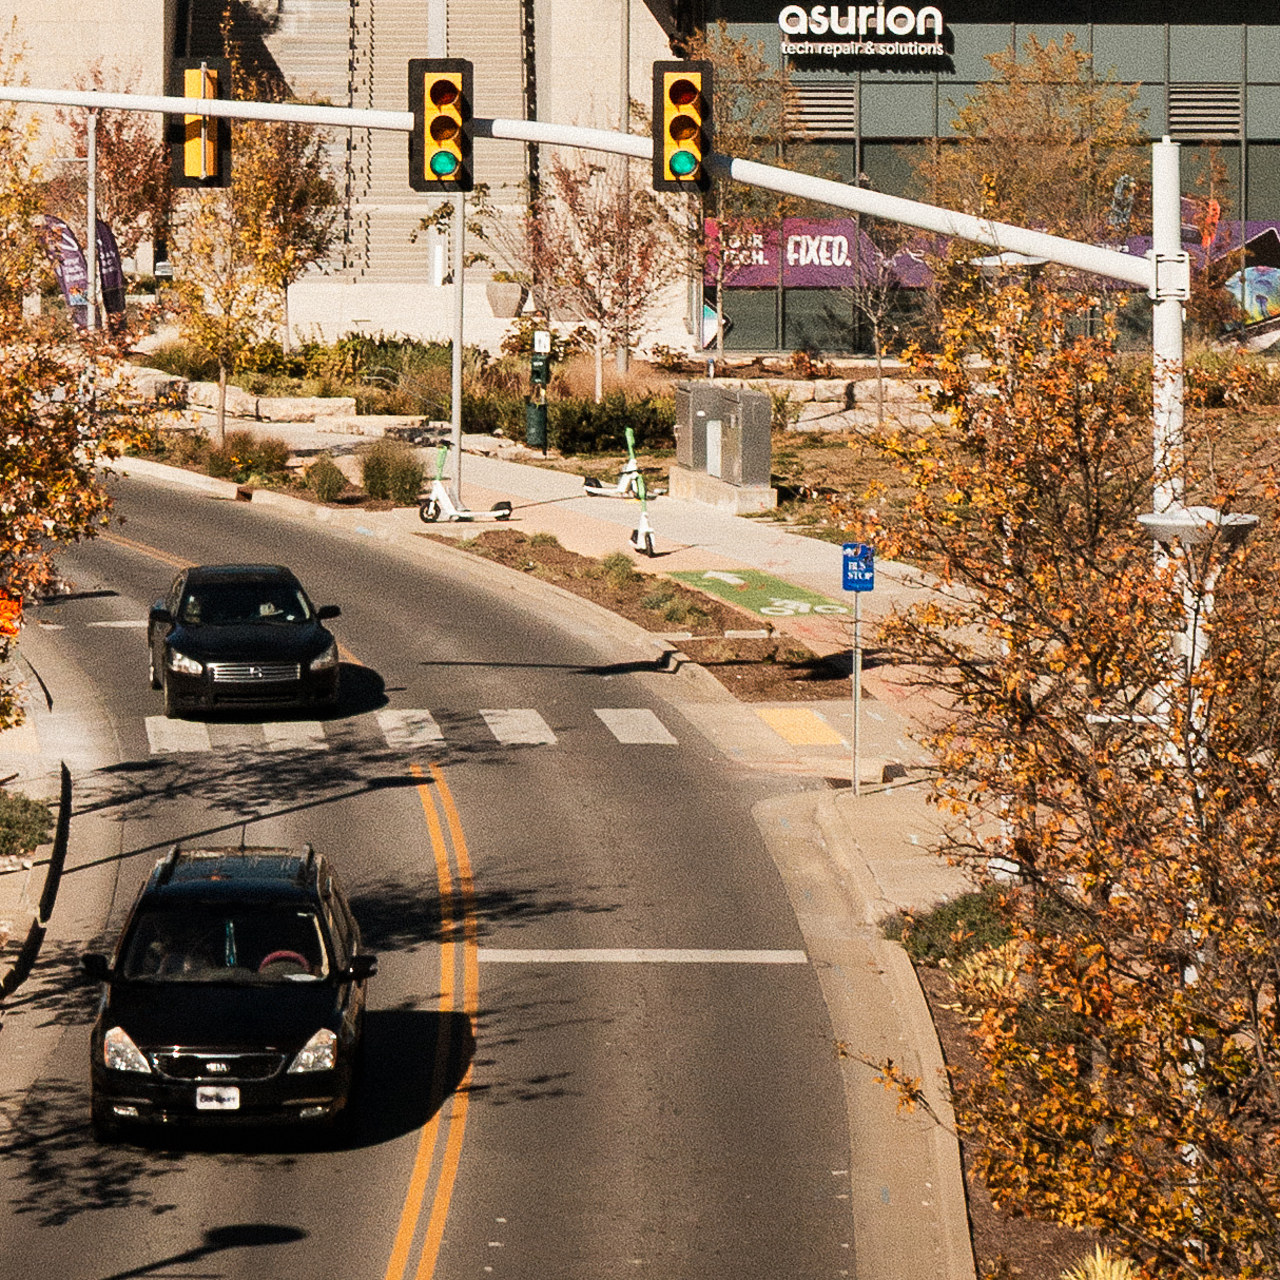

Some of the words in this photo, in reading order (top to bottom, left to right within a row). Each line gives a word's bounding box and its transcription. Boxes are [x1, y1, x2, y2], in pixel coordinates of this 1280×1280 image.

[781, 41, 814, 55] tech
[818, 41, 863, 57] repair
[865, 41, 875, 55] &
[879, 41, 944, 55] solutions
[786, 235, 852, 266] FIXED.
